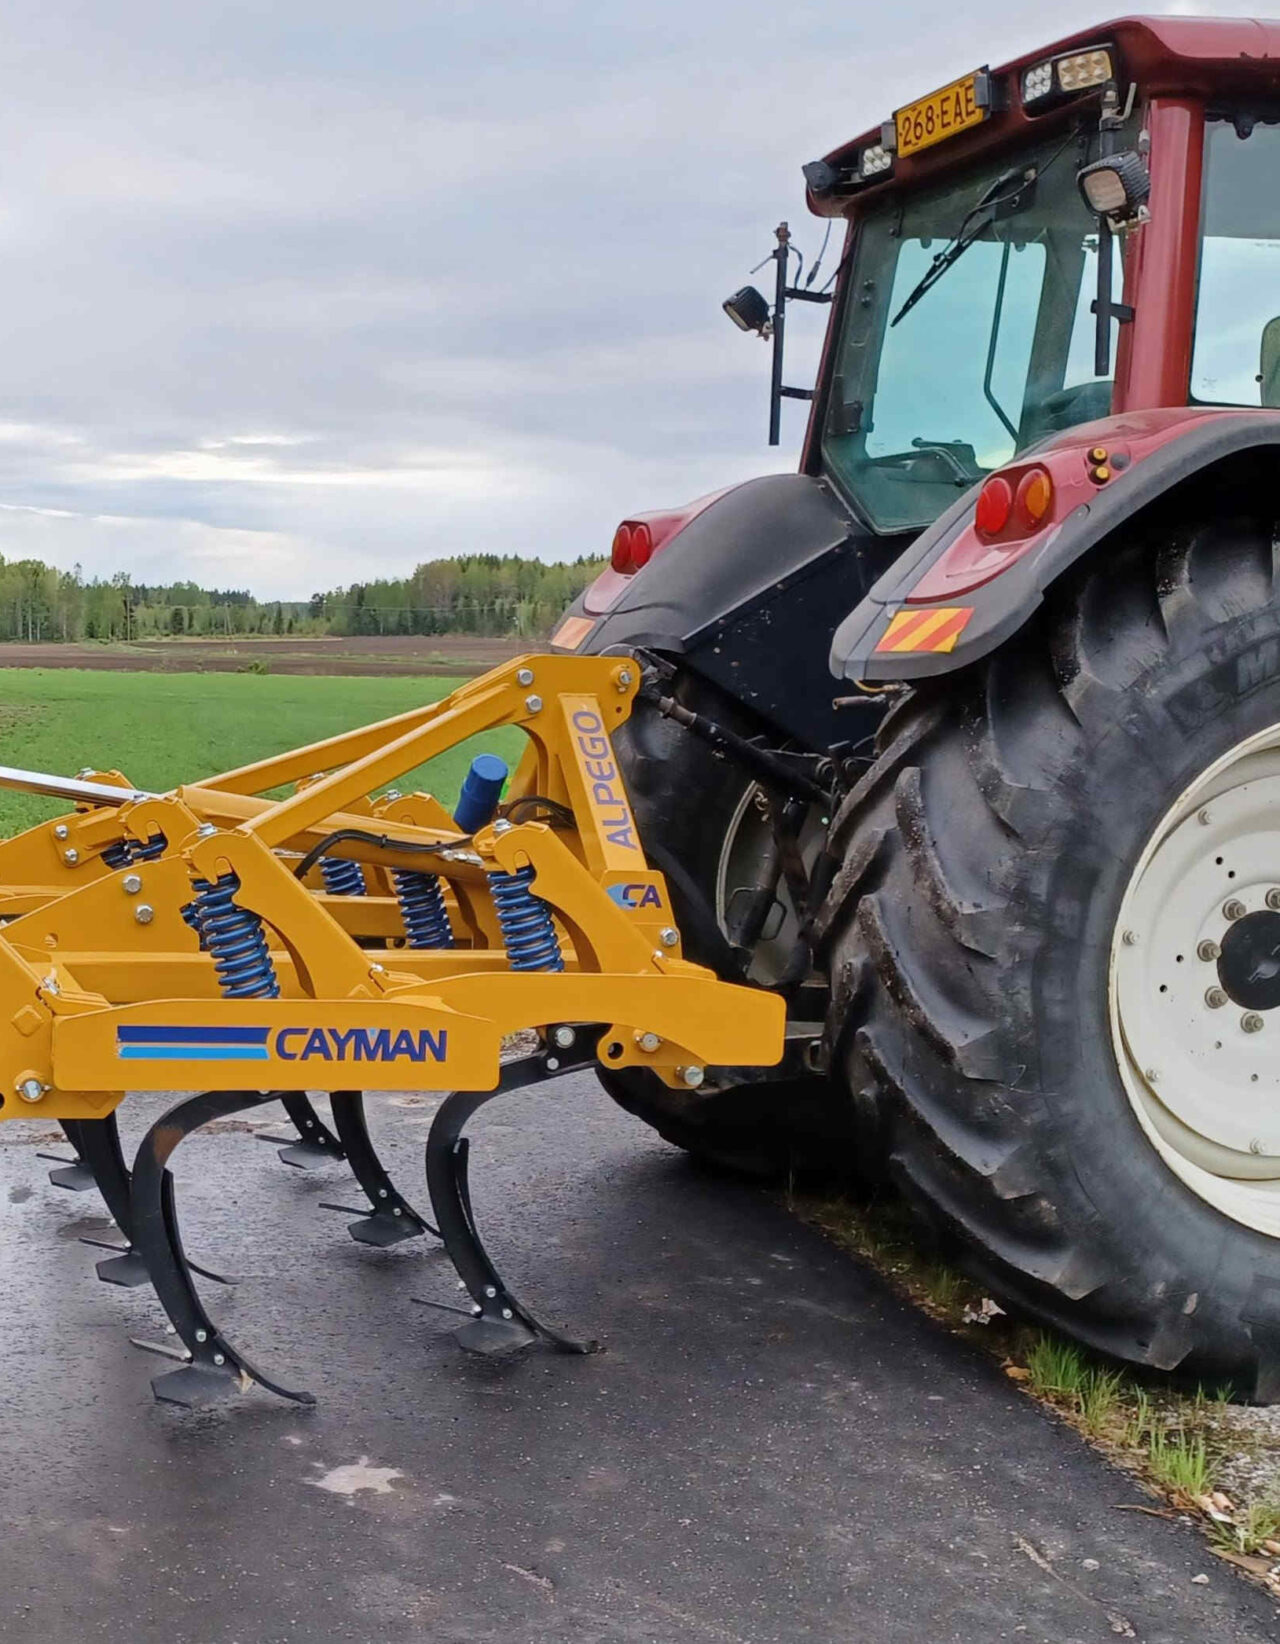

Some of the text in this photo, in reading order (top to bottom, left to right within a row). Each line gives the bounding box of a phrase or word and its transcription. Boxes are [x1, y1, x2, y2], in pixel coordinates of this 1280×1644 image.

[572, 710, 638, 851] ALPEGO
[622, 884, 663, 909] CA
[275, 1027, 448, 1062] CAYMAN
